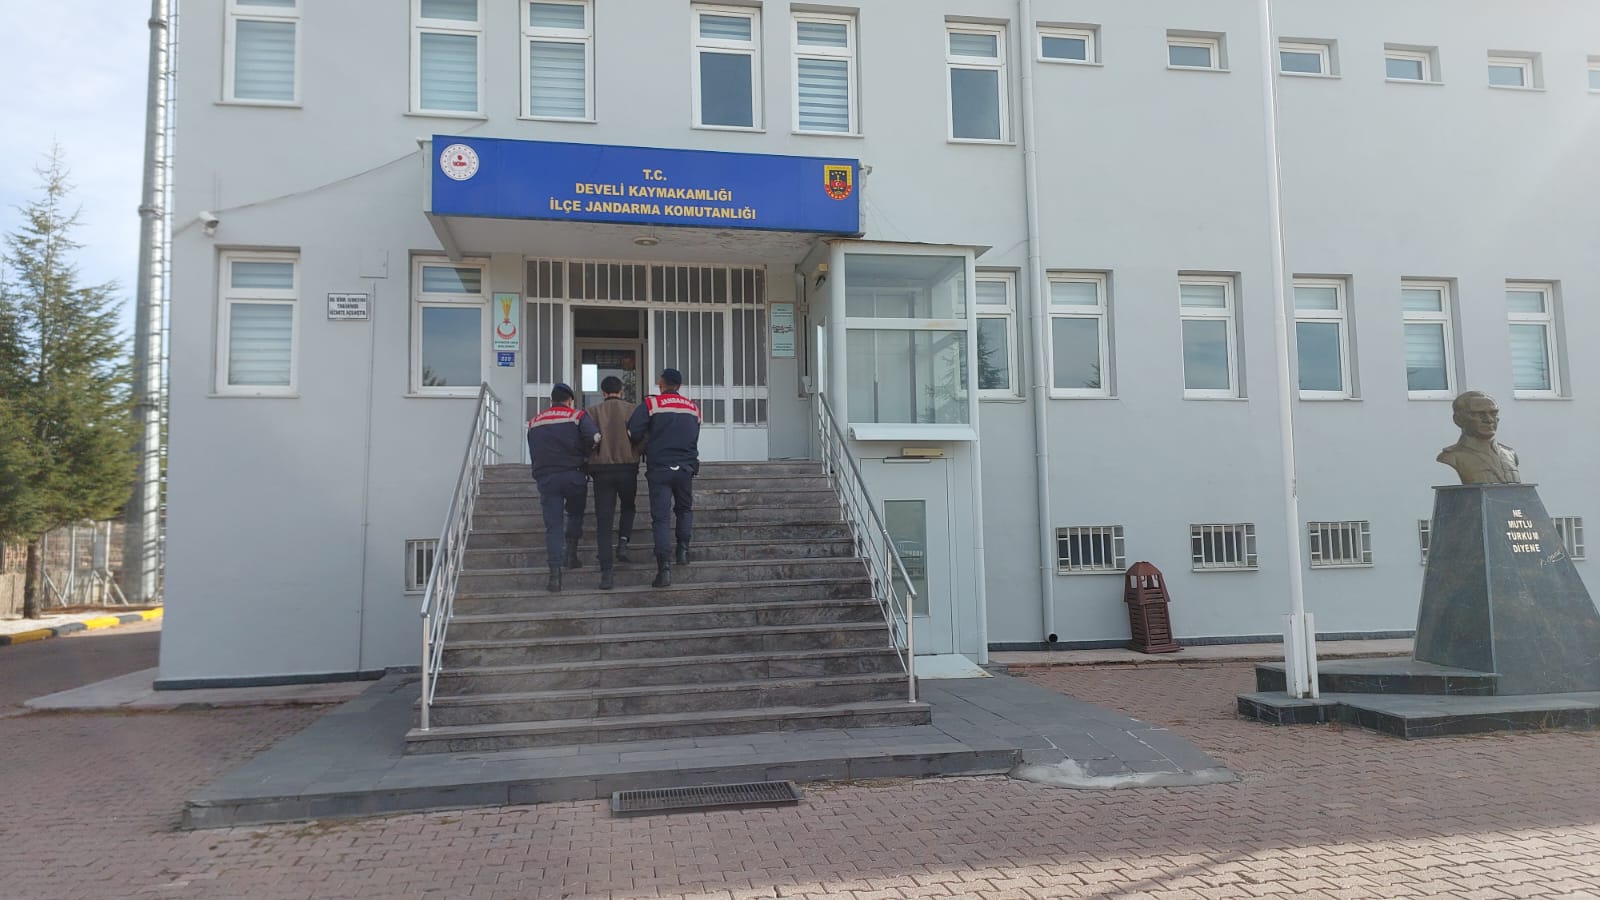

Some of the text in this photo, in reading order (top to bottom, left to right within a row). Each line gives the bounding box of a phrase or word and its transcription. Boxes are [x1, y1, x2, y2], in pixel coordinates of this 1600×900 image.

[643, 169, 667, 181] T.C.
[575, 183, 732, 201] DEVELİ KAYMAKAMLIĞI
[550, 197, 756, 219] İLÇE JANDARMA KOMUTANLIĞI
[1512, 509, 1523, 518] NE
[1508, 520, 1533, 529] MUTLU
